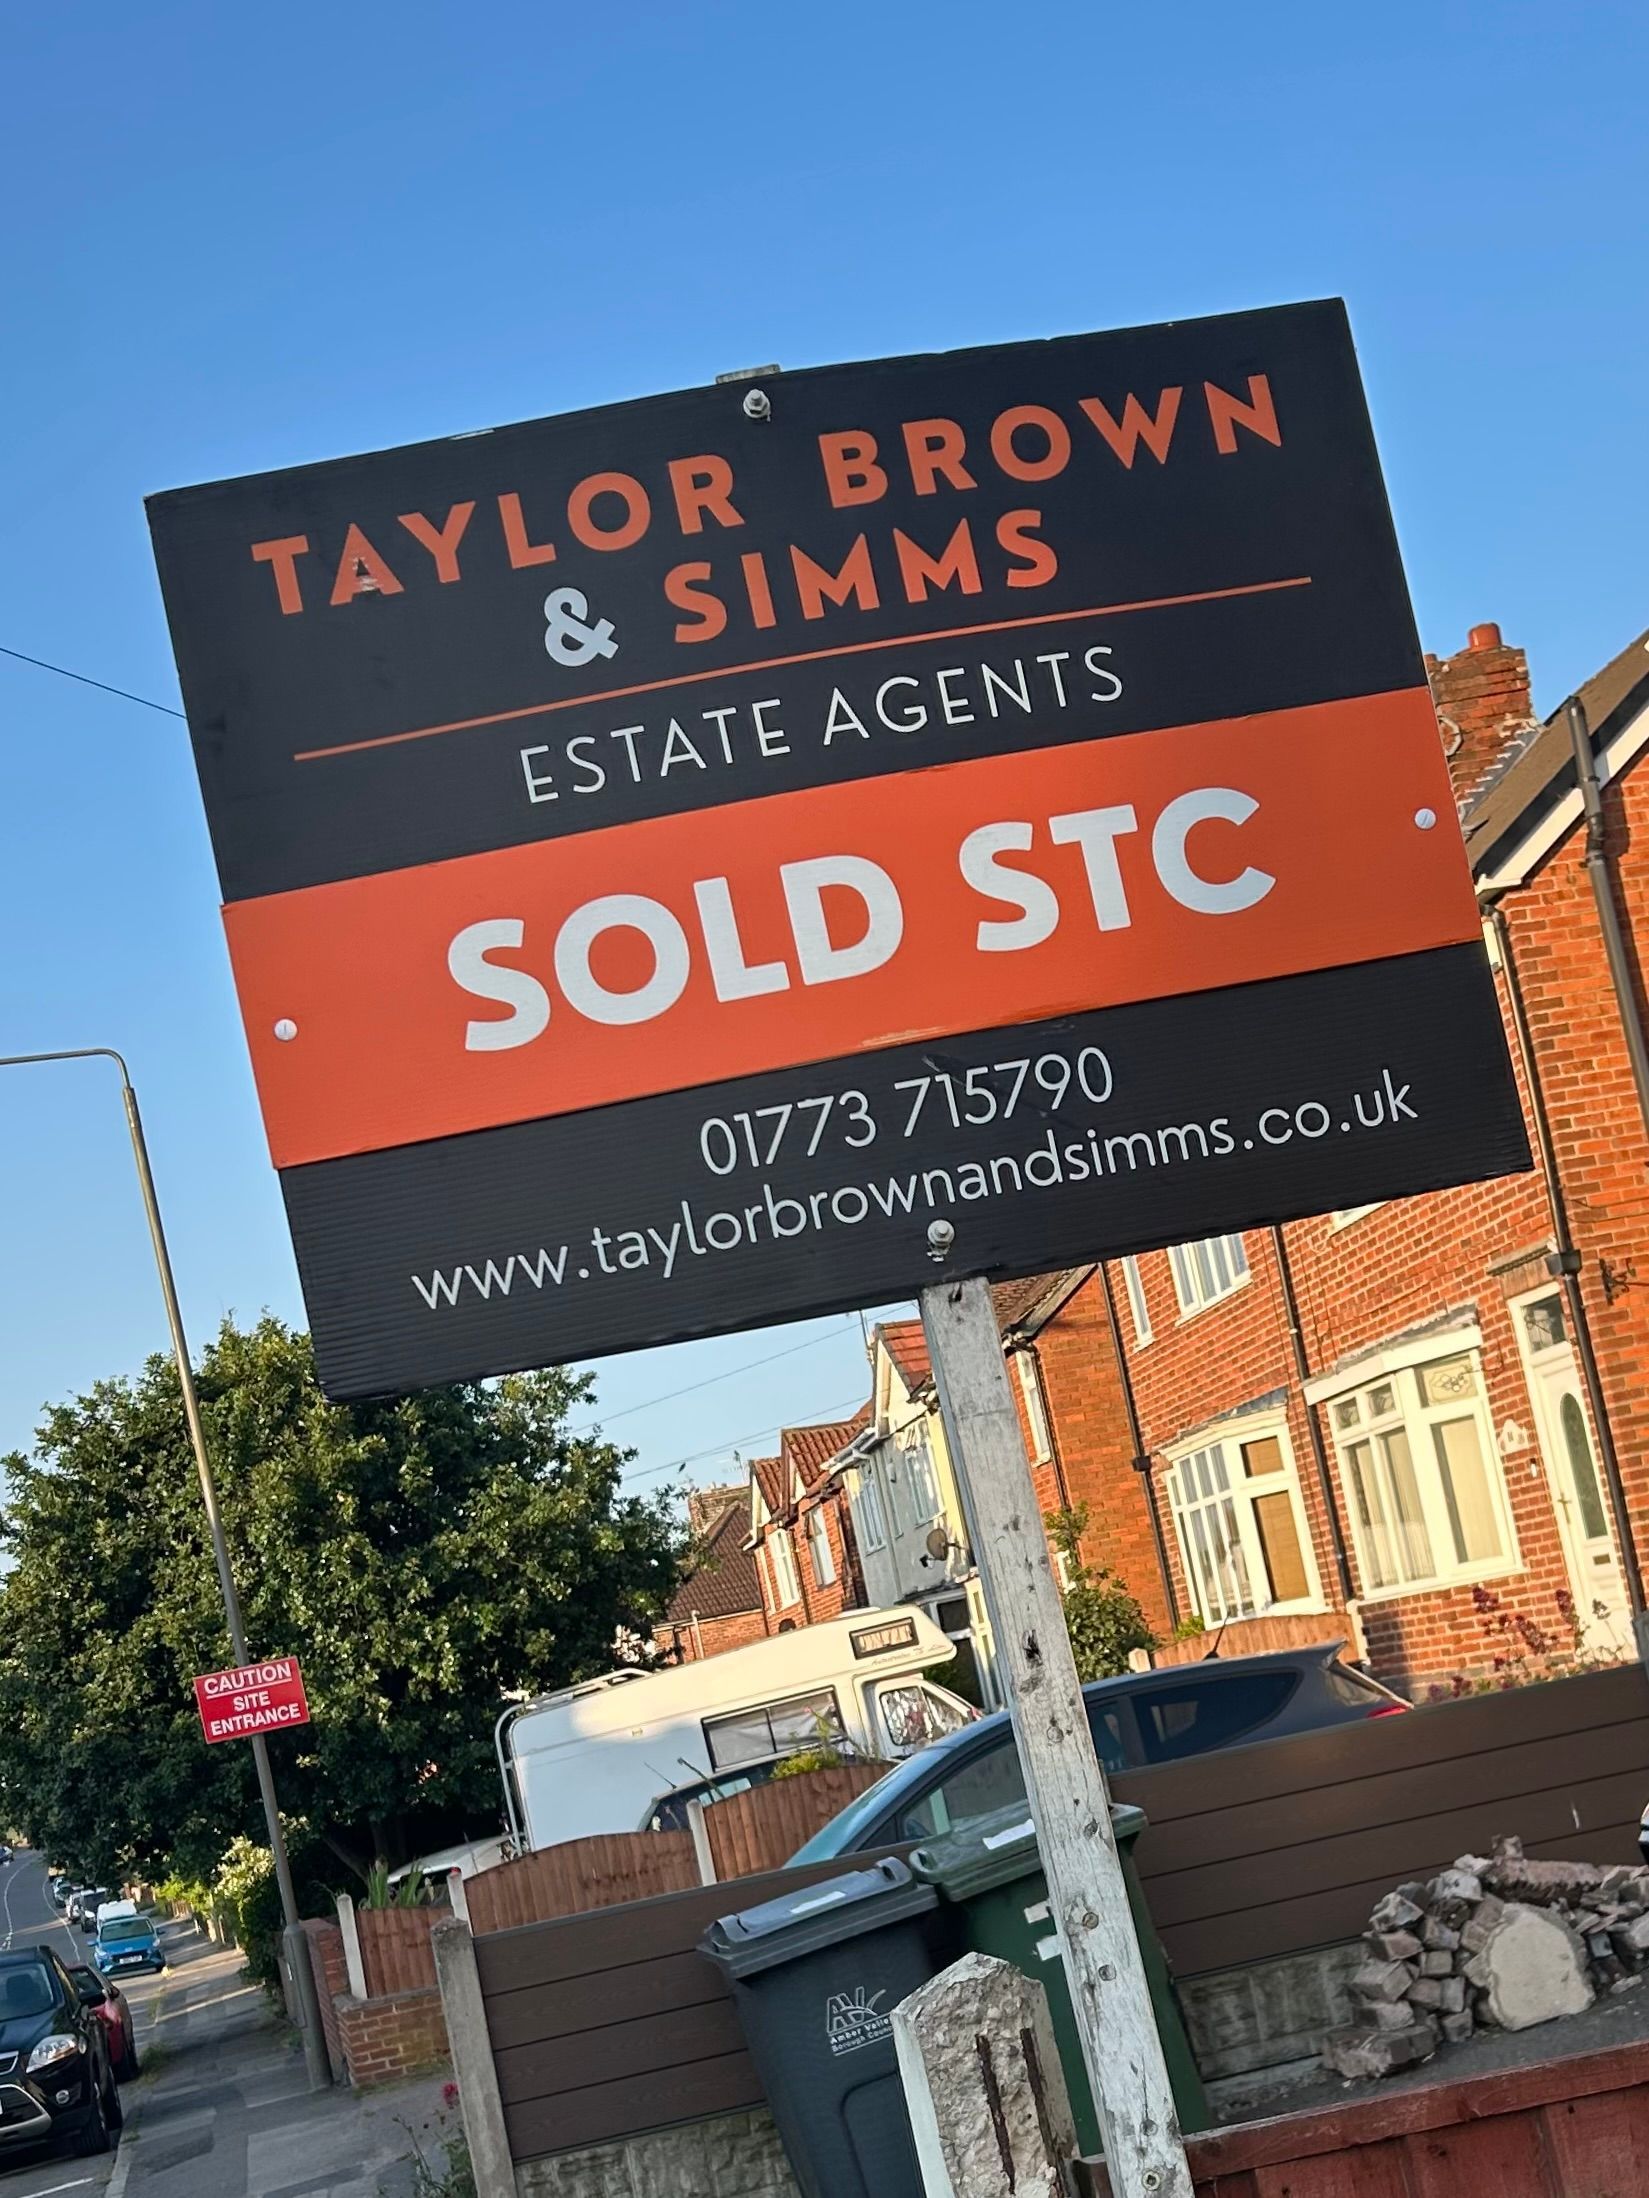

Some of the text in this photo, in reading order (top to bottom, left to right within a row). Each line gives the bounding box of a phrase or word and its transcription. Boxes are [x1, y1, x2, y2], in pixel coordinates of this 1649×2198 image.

[251, 373, 1284, 616] TAYLOR BROWN
[542, 508, 1060, 668] & SIMMS
[518, 644, 1125, 805] ESTATE AGENTS
[446, 786, 1277, 1054] SOLD STC
[410, 1069, 1420, 1312] www.taylorbrownandsimms.co.uk
[698, 1045, 1115, 1178] 01773 715790
[203, 1661, 292, 1695] CAUTION
[210, 1702, 301, 1736] ENTRANCE
[232, 1690, 272, 1712] SITE
